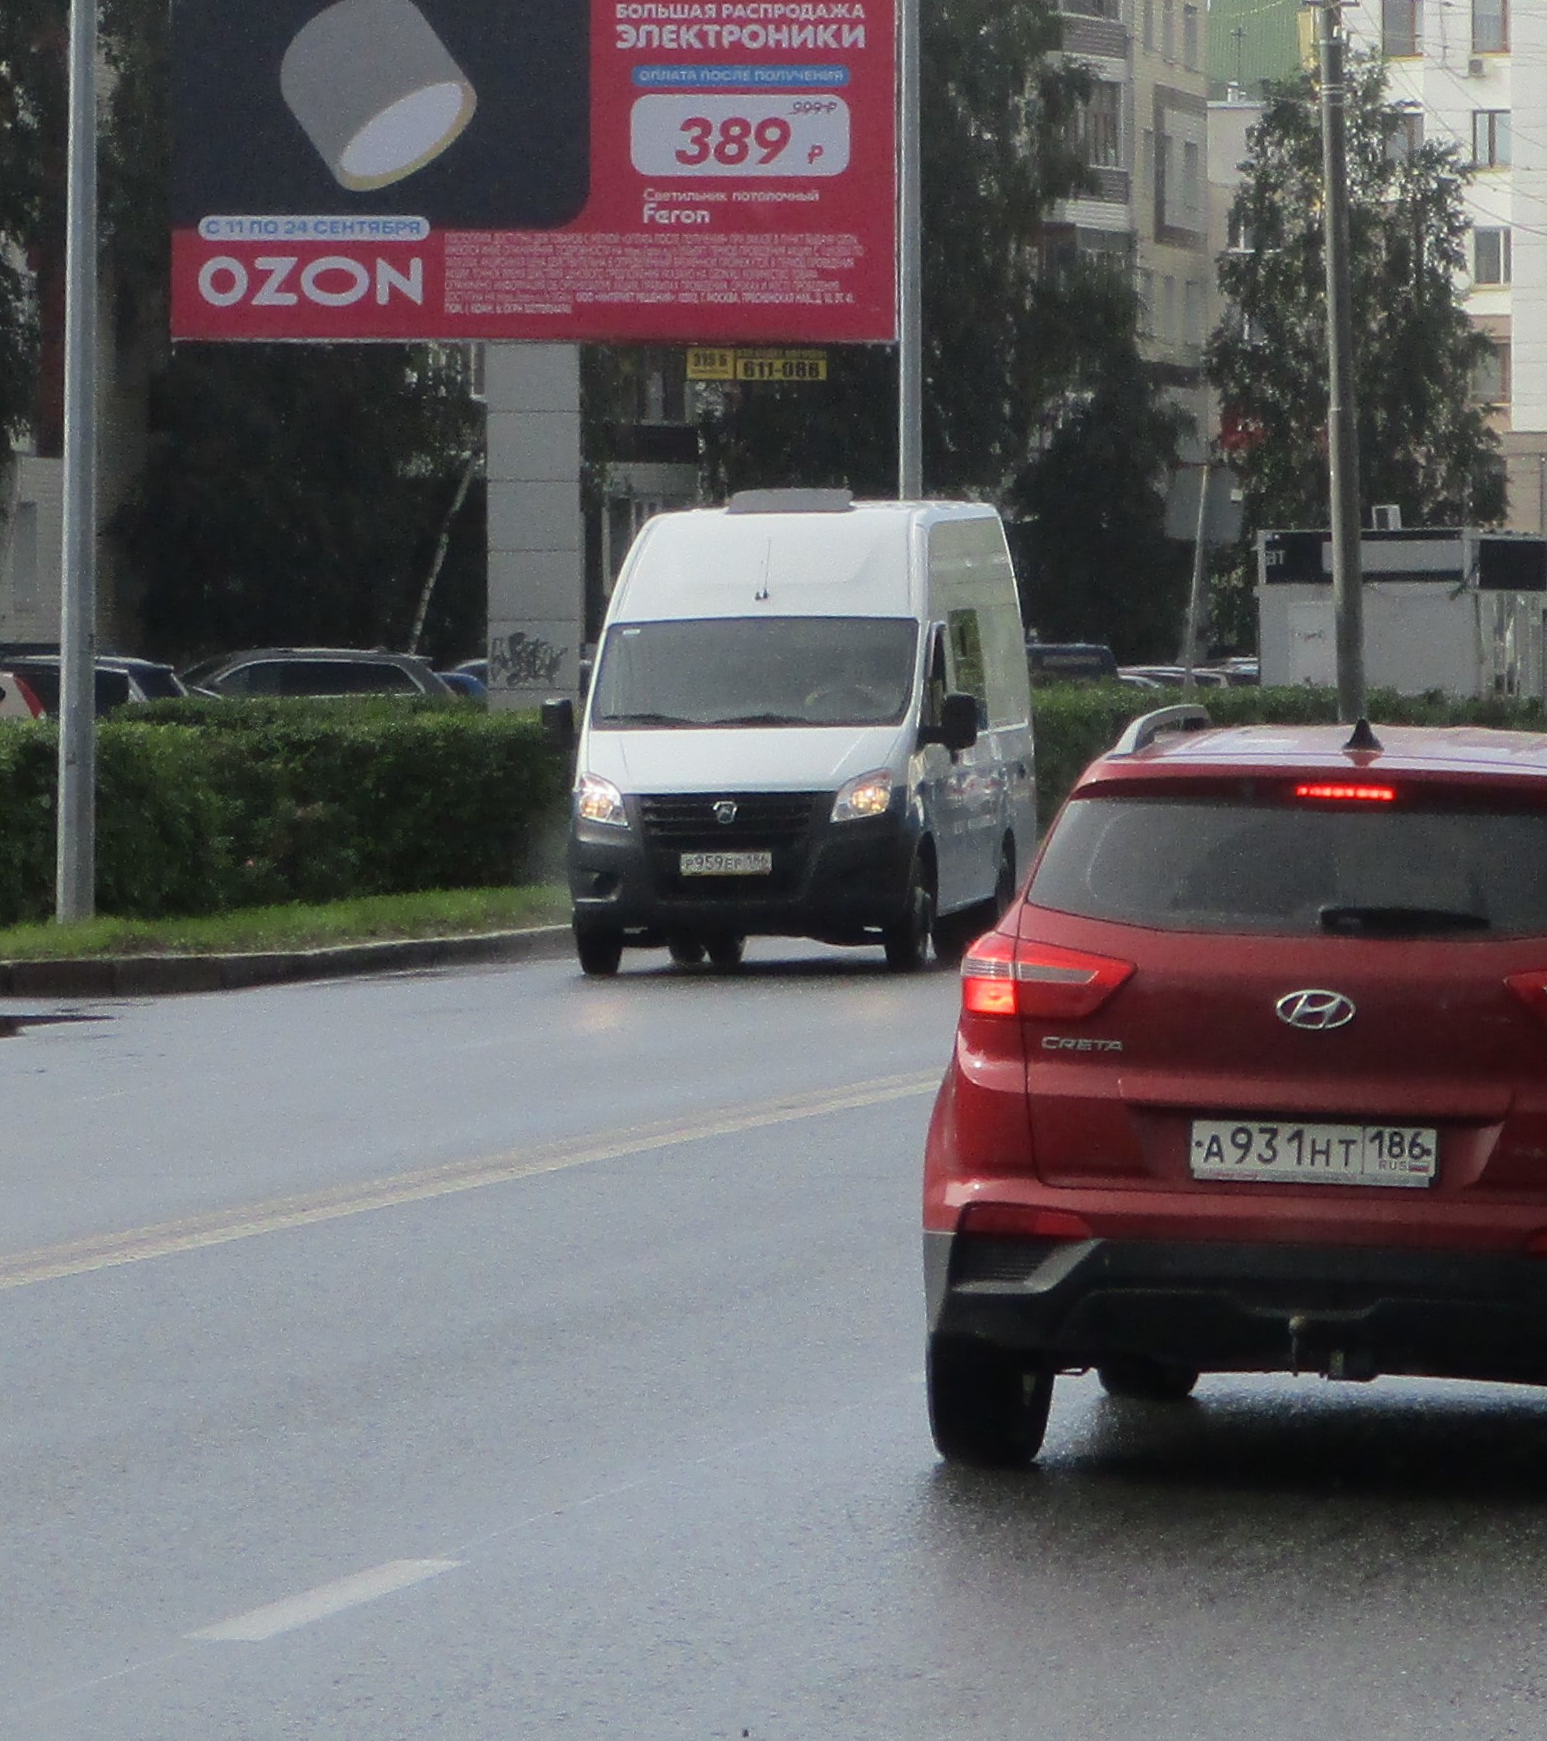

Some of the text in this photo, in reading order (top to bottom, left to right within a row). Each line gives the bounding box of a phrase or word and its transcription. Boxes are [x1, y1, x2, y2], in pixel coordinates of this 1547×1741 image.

[615, 3, 866, 21] БОЛЬШАЯ РАСПРОДАЖА
[615, 24, 866, 50] ЭЛЕКТРОНИКИ
[638, 70, 845, 82] ОПЛАТА ПОСЛЕ ПОЛУЧЕНИЯ
[674, 116, 793, 167] 389
[642, 188, 820, 202] Светильник потолочный
[642, 203, 711, 224] Feron
[205, 220, 422, 235] С 11 ПО 24 СЕНТЯБРЯ
[198, 255, 424, 307] OZON
[1041, 1035, 1124, 1052] CRETA
[1203, 1126, 1427, 1168] А931НТ 186
